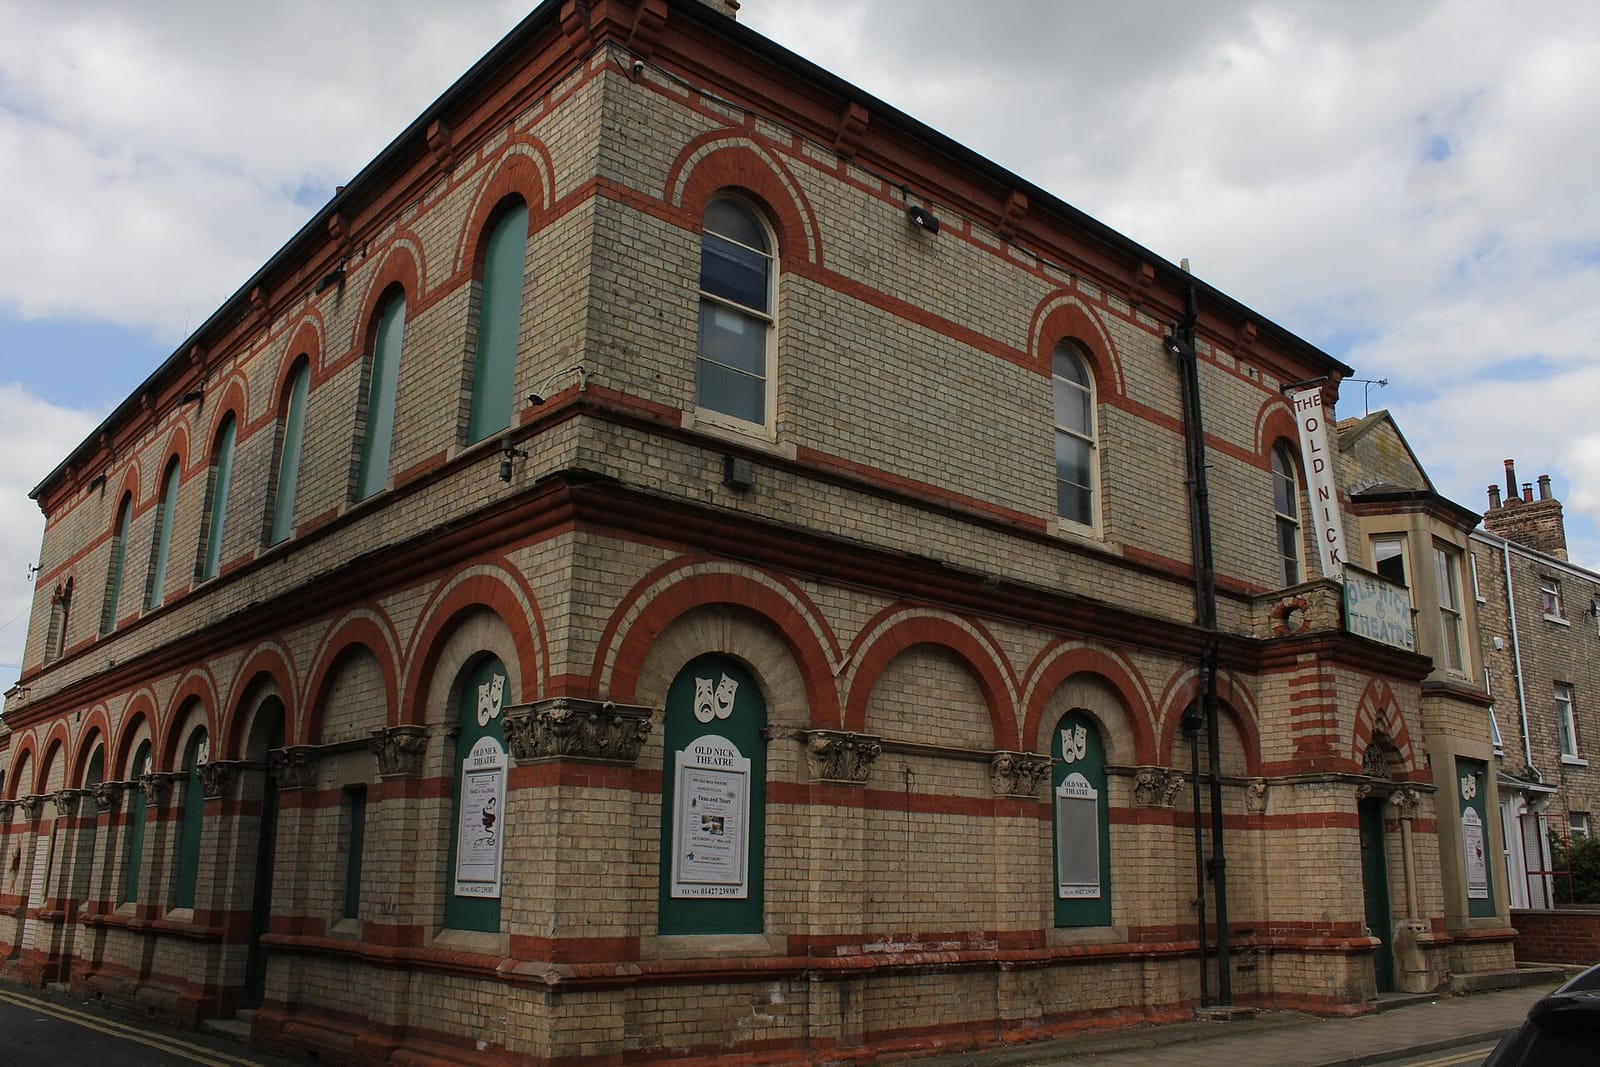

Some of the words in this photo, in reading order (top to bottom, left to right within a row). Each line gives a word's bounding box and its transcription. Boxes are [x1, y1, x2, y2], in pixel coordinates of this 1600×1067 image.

[1293, 394, 1321, 412] THE
[1305, 418, 1325, 474] OLD
[1318, 485, 1341, 565] NICK
[1347, 577, 1376, 606] OLD
[1379, 580, 1410, 622] NICK
[1349, 610, 1413, 649] THEATRE
[694, 746, 713, 756] OLD
[714, 748, 735, 758] NICK
[695, 755, 734, 767] THEATRE
[1065, 780, 1076, 788] OLD
[1065, 788, 1089, 796] THEATRE
[700, 887, 718, 896] 01427
[719, 887, 739, 896] 239387
